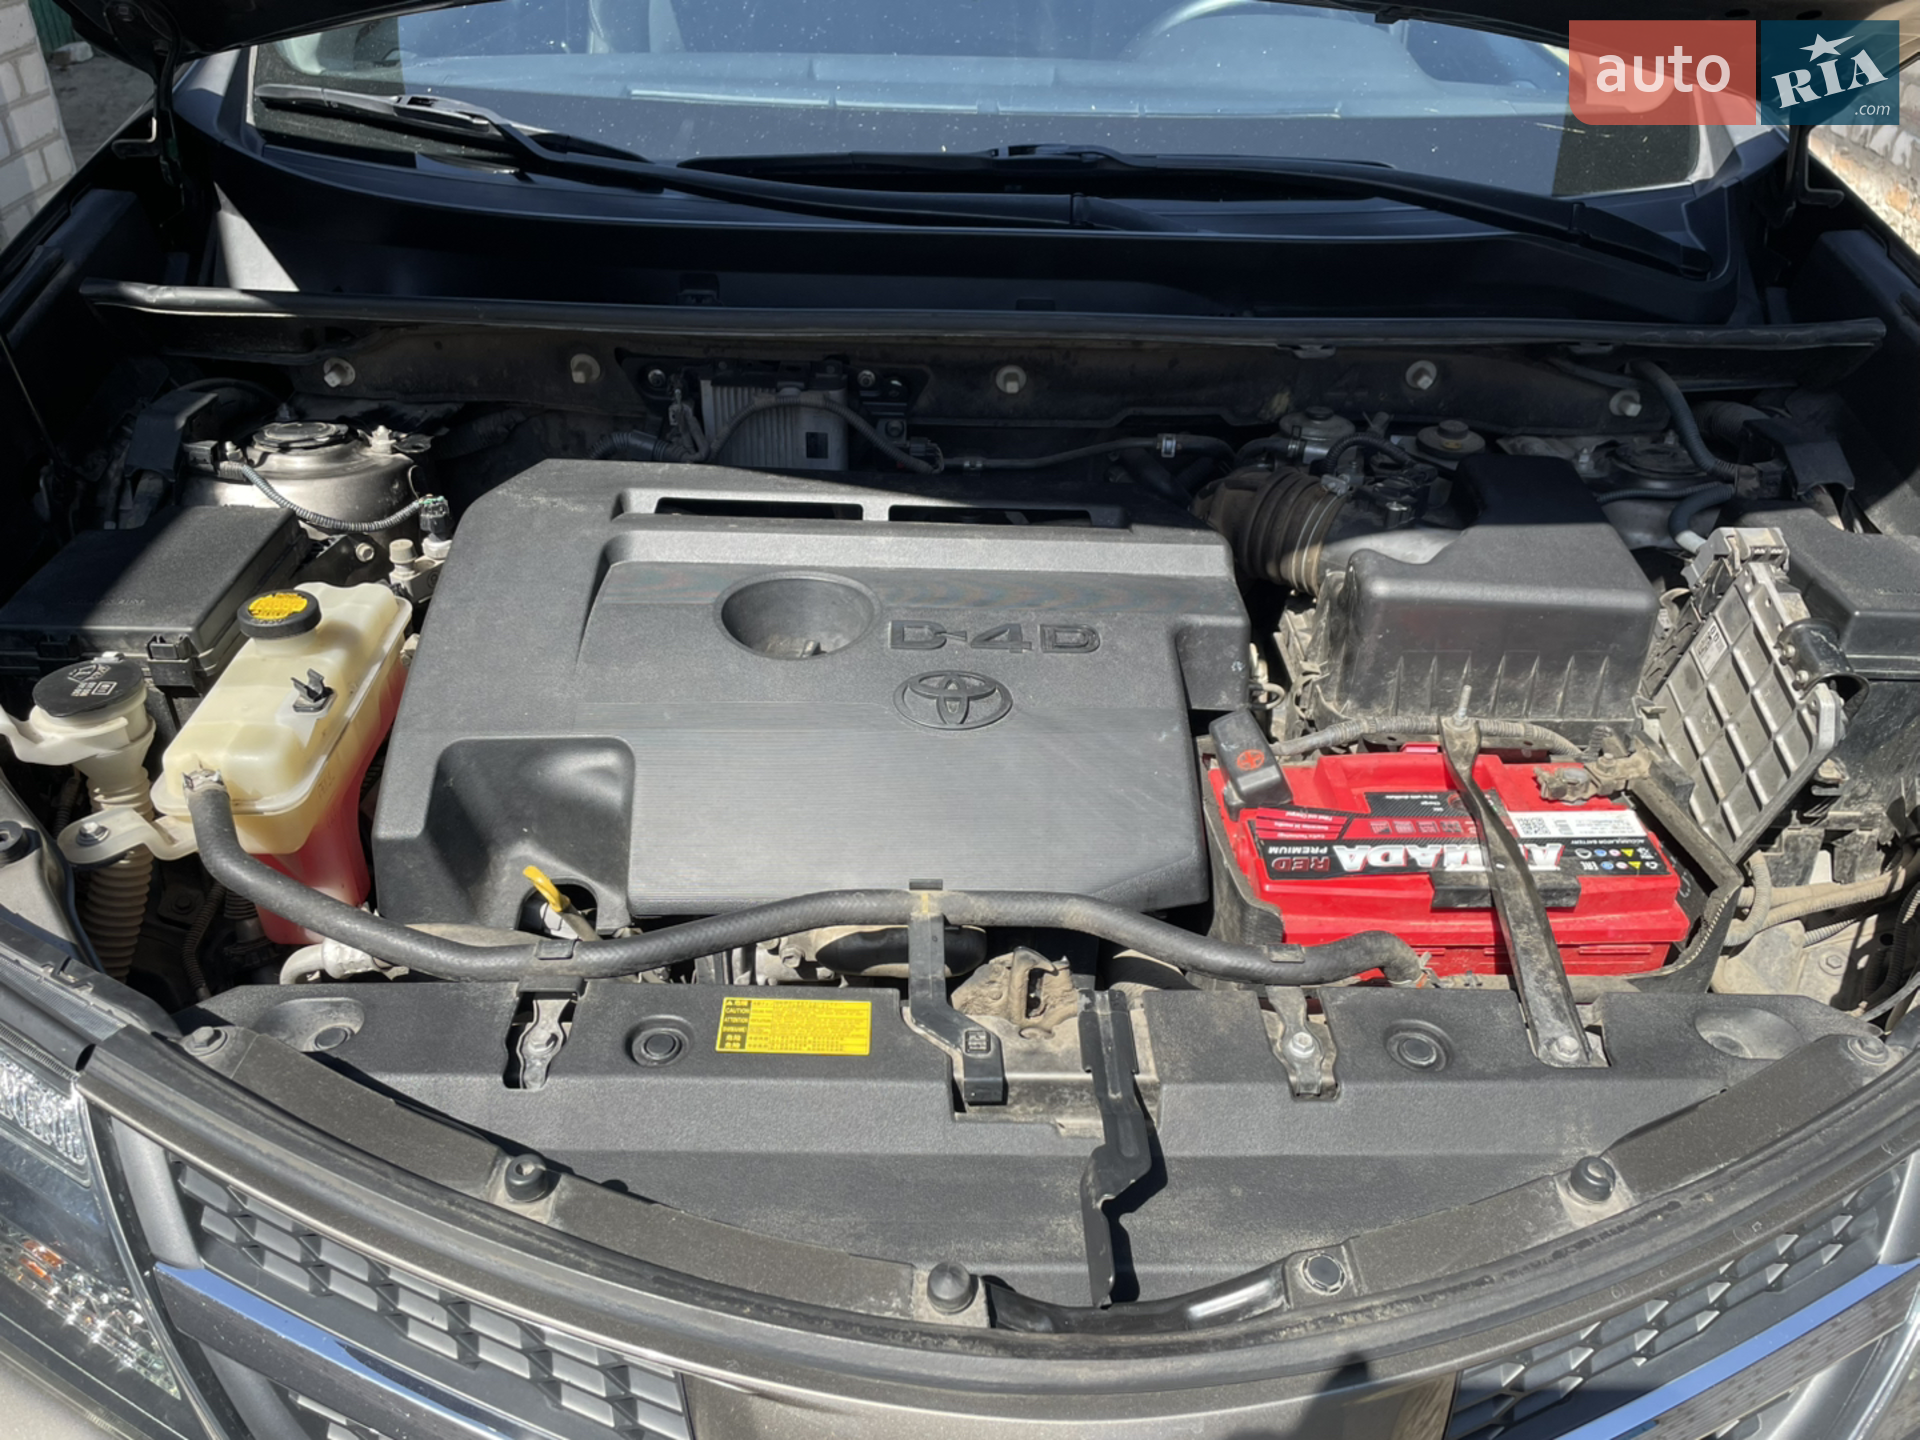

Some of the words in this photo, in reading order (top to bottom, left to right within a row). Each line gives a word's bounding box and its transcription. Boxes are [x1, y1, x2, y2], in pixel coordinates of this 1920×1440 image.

[888, 619, 1101, 654] D-4D
[1268, 846, 1329, 854] PREMIUM
[1332, 844, 1566, 871] AMADA
[1271, 857, 1330, 872] RED
